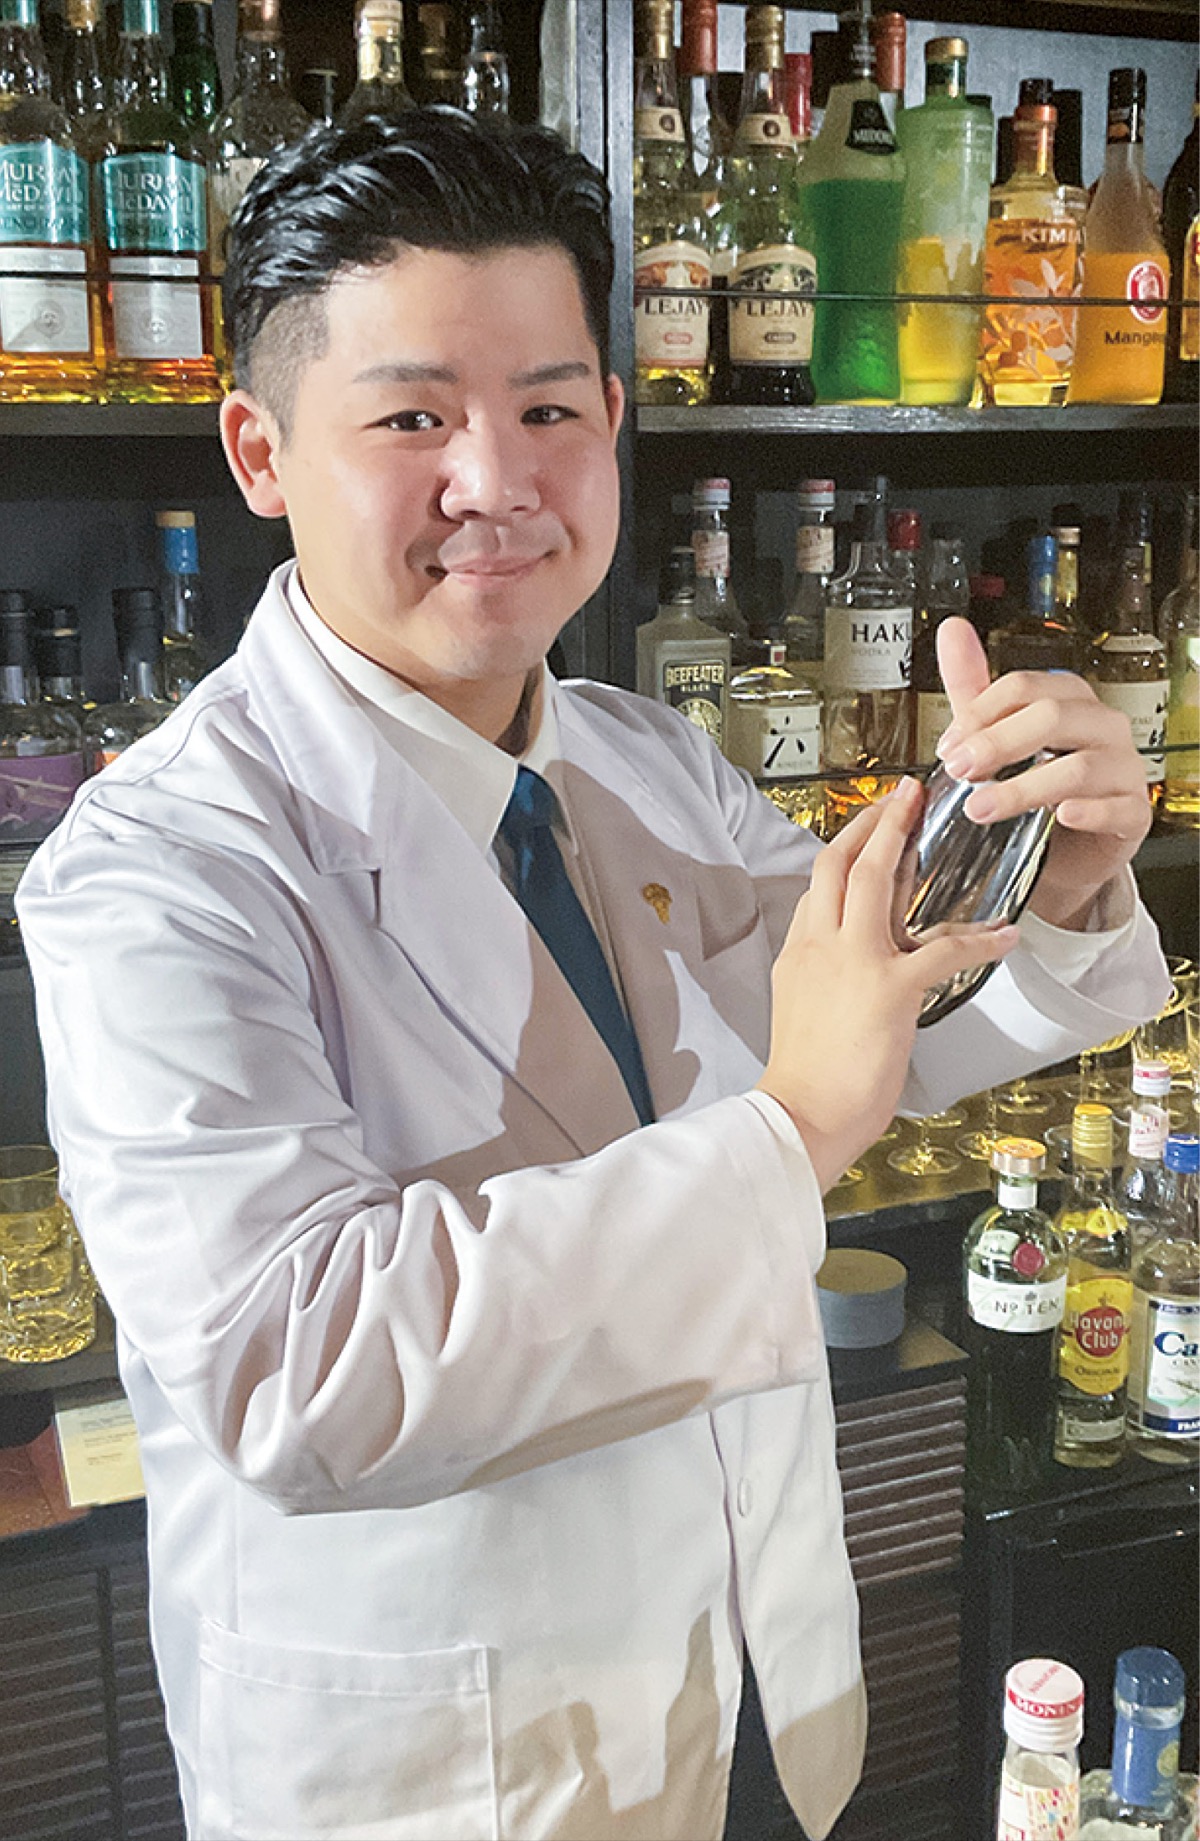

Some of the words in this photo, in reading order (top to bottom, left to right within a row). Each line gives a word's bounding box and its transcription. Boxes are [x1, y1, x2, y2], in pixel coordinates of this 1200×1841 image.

[666, 665, 725, 688] BEEFEATER
[1081, 1331, 1119, 1349] Club
[1017, 1697, 1077, 1716] MONIN
